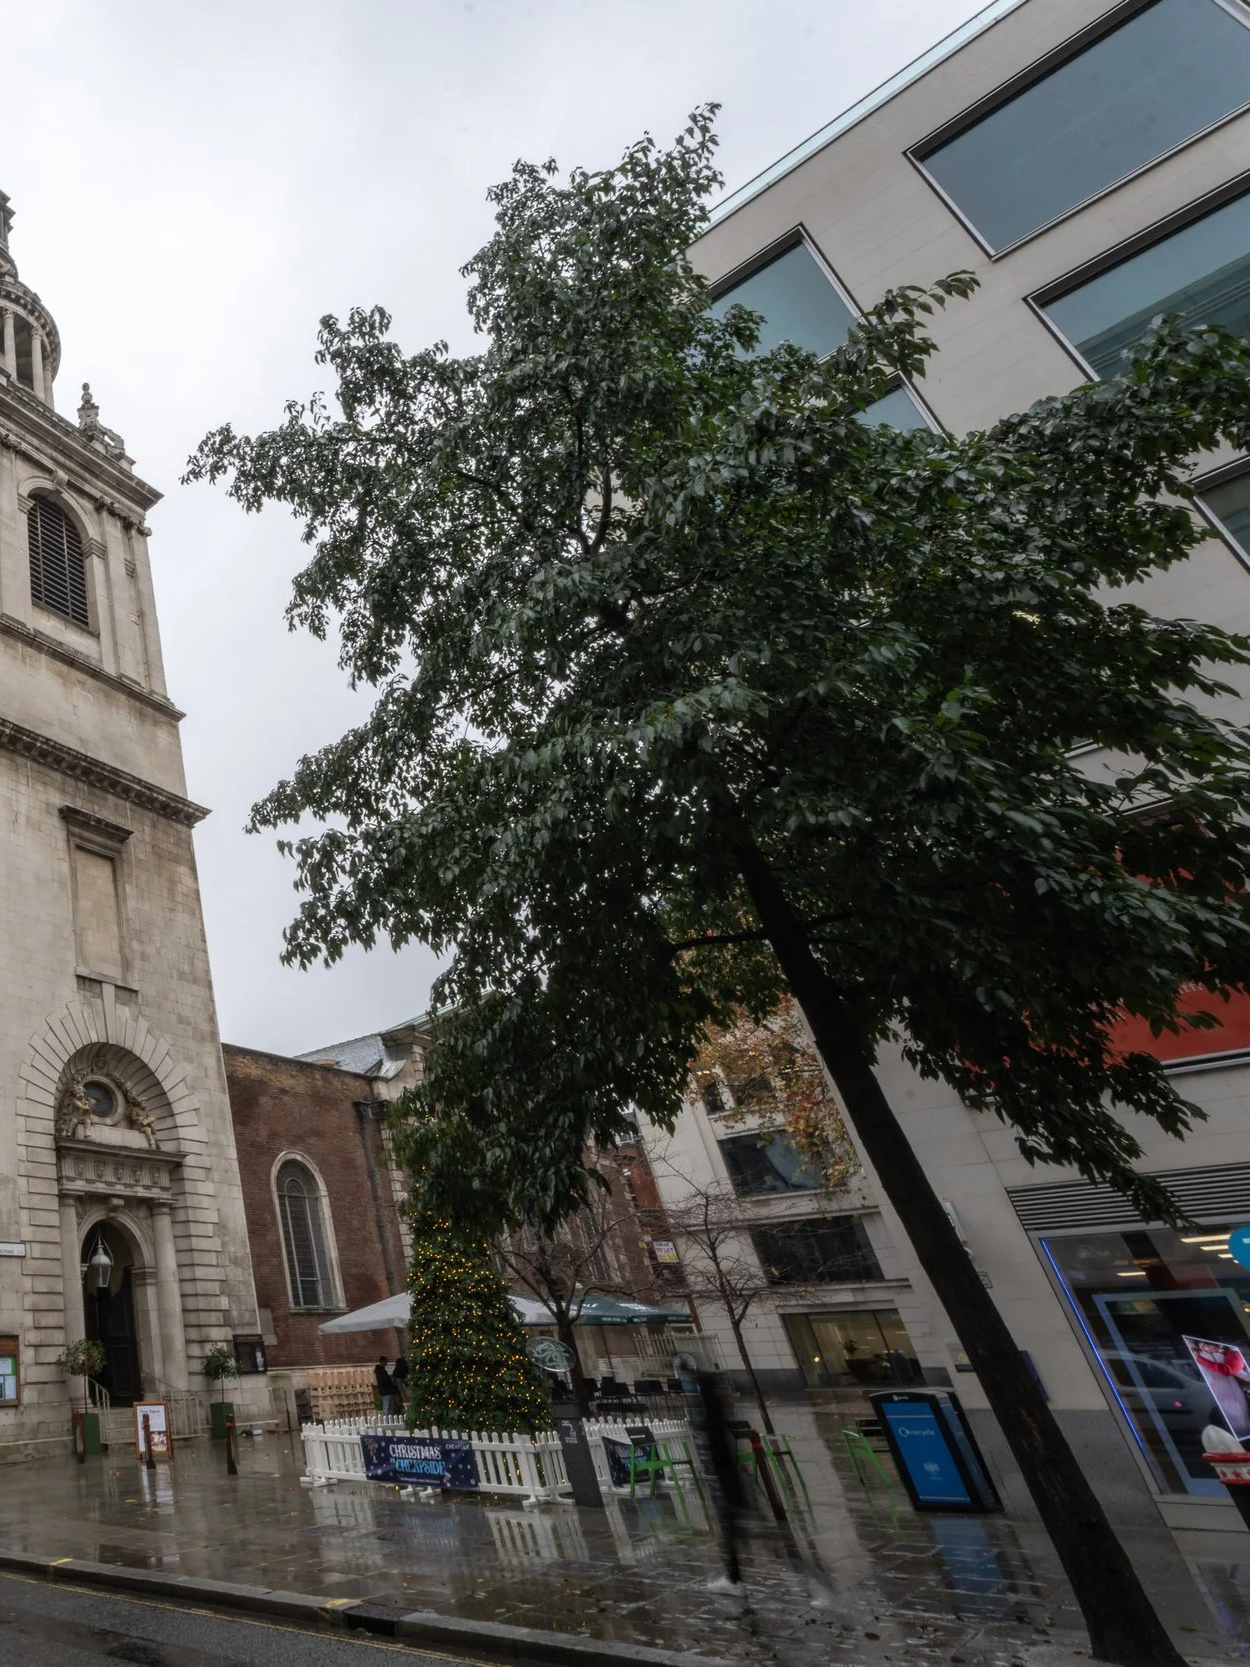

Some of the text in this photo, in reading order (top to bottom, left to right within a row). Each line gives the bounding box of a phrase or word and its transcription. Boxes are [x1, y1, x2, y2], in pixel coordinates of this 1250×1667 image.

[909, 1428, 935, 1437] recycle
[389, 1444, 442, 1460] CHRISTMAS
[395, 1458, 447, 1475] CHEAPSIDE
